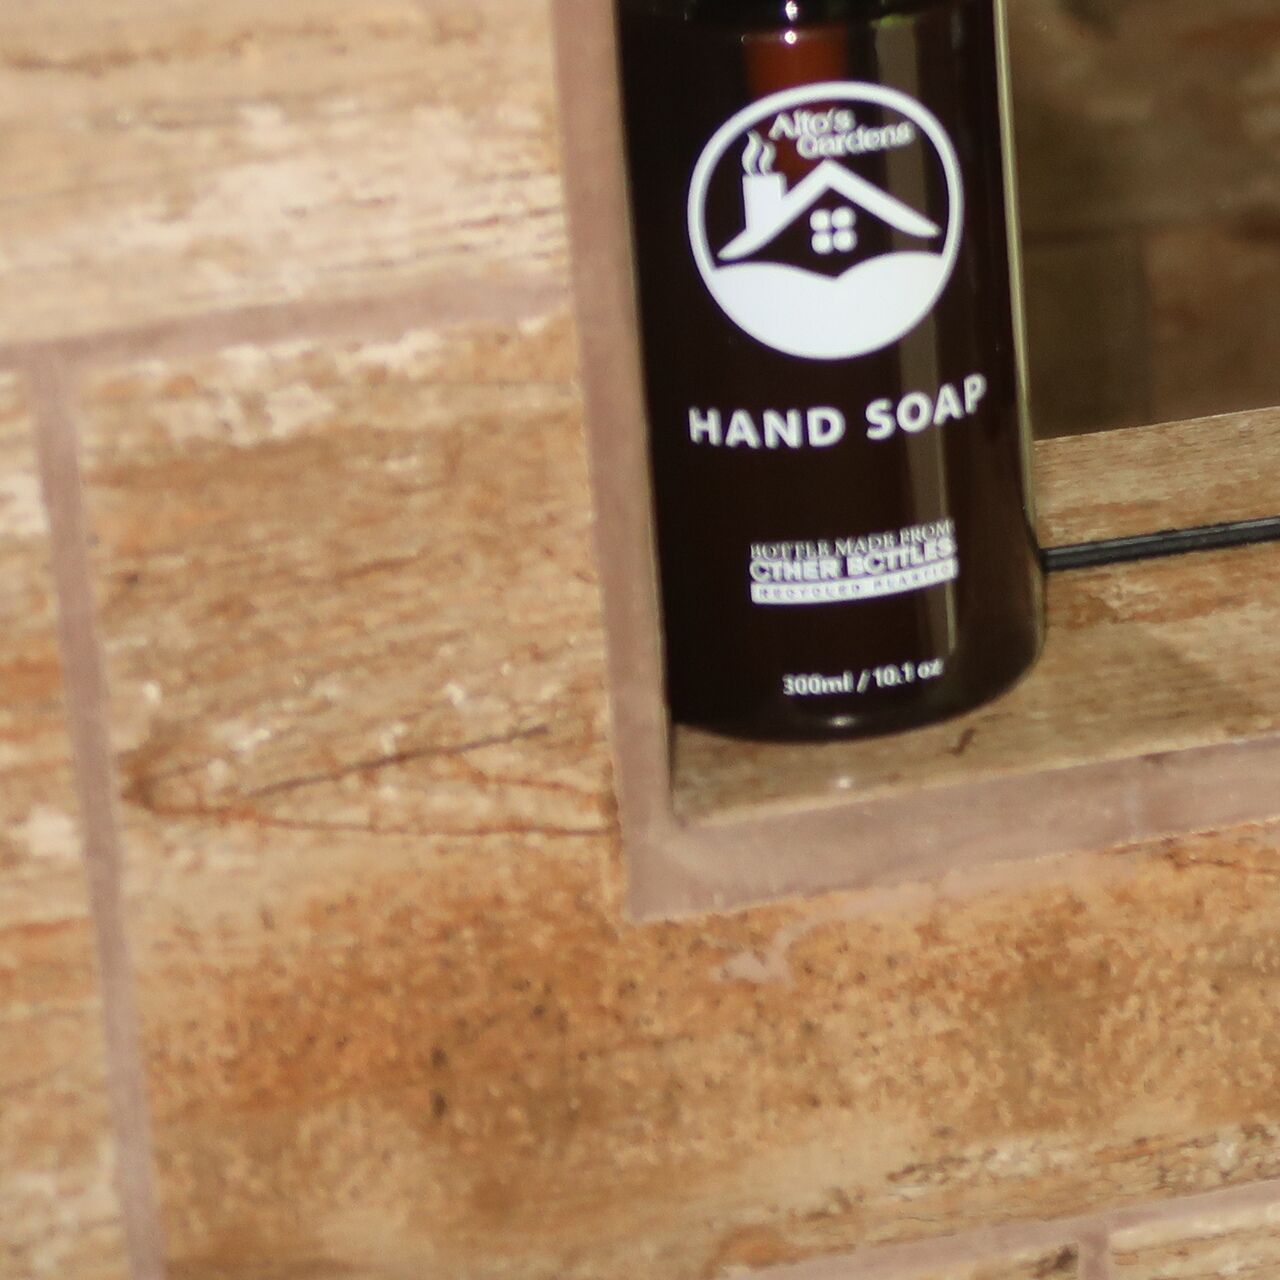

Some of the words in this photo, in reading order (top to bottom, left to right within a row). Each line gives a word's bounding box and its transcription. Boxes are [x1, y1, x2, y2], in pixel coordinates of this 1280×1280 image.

[688, 406, 846, 449] HAND
[865, 373, 988, 441] SOAP
[782, 671, 854, 696] 300ml
[856, 669, 871, 694] /
[872, 660, 915, 687] 10.1
[917, 658, 944, 680] oz
